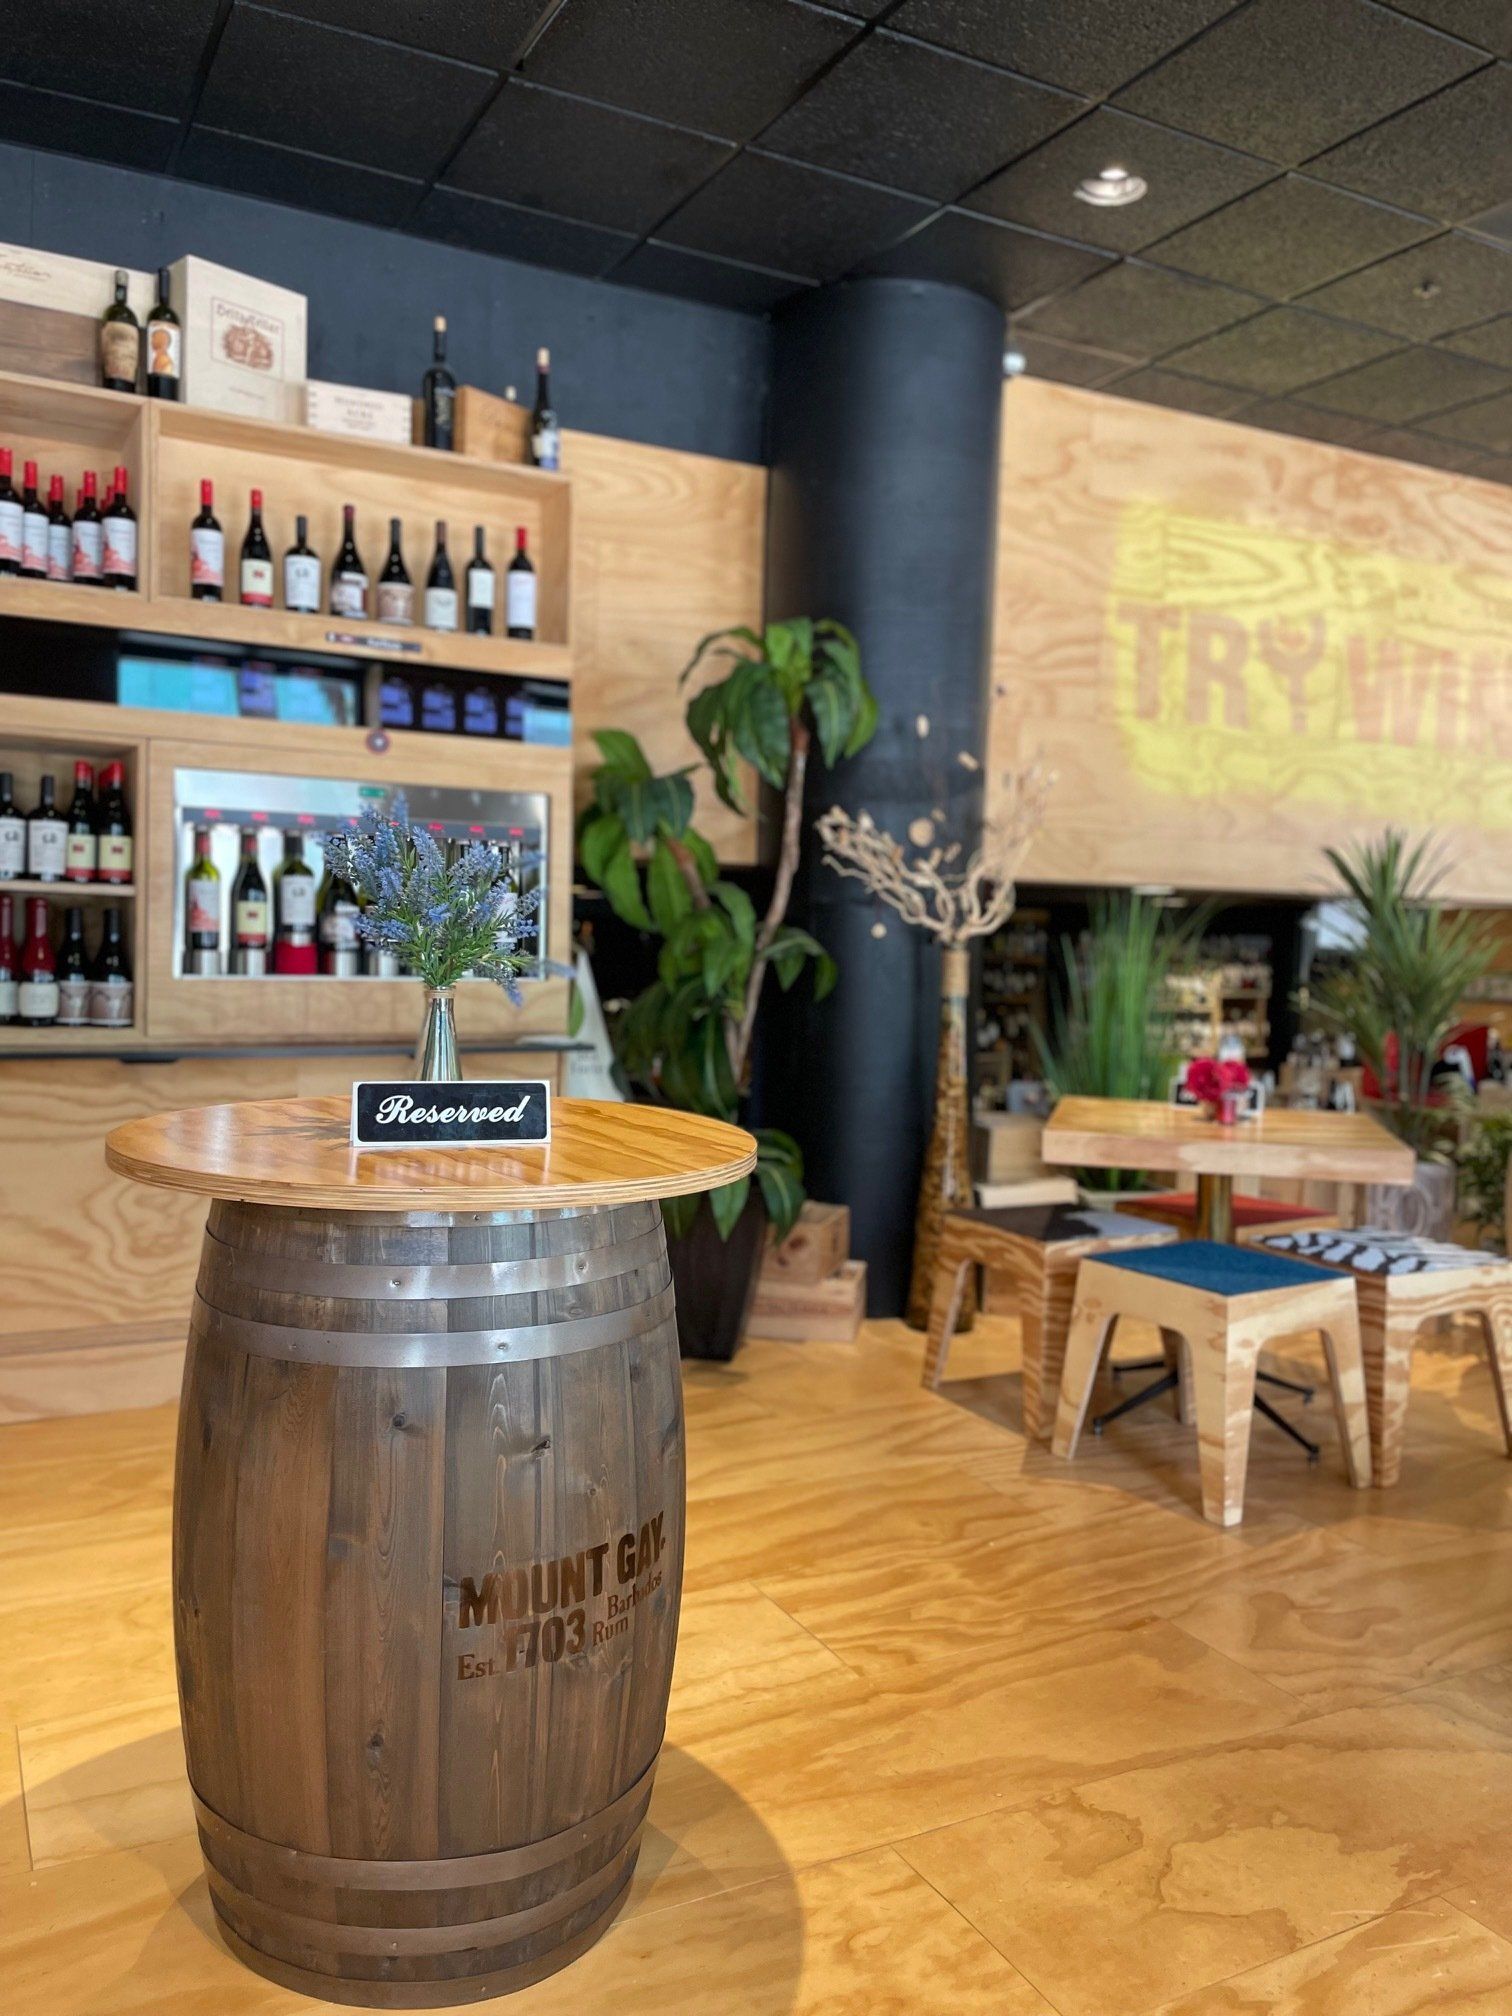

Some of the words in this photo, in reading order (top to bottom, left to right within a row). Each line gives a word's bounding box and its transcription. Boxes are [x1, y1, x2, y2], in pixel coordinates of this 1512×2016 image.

[1115, 602, 1327, 735] TRY
[374, 1094, 531, 1125] Reserved
[458, 1542, 609, 1629] MOUNT
[606, 1570, 662, 1621] Barbados
[505, 1608, 586, 1673] 1703
[591, 1616, 629, 1648] Rum
